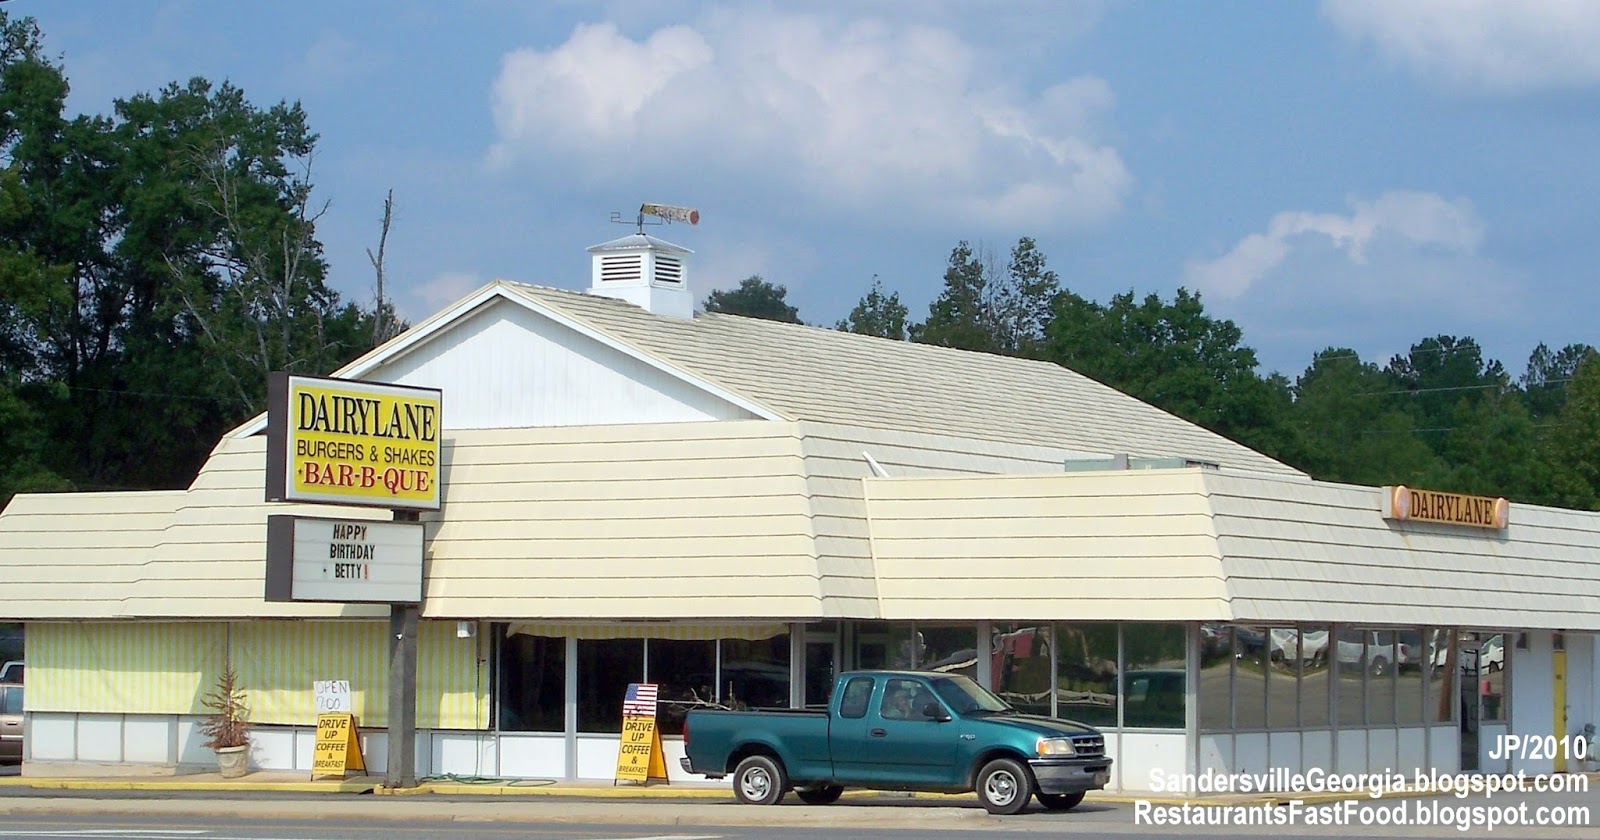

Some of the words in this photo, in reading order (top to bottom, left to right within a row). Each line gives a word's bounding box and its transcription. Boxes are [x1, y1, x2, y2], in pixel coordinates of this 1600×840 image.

[298, 392, 435, 441] DAIRYLANE
[297, 439, 364, 461] BURGERS
[370, 445, 379, 462] &
[384, 446, 435, 467] SHAKES
[303, 461, 429, 494] BAR-B-QUE
[1411, 492, 1492, 524] DAIRYLANE
[333, 524, 368, 541] HAPPY
[329, 543, 375, 560] BIRTHDAY
[316, 681, 348, 694] OPEN
[319, 719, 347, 728] DRIVE
[625, 722, 653, 731] DRIVE
[324, 730, 338, 740] UP
[631, 732, 645, 742] UP
[316, 742, 346, 752] COFFEE
[621, 744, 650, 755] COFFEE
[327, 752, 333, 760] &
[631, 756, 637, 764] &
[314, 760, 344, 768] BREAKFAST
[618, 765, 647, 773] BREAKFAST
